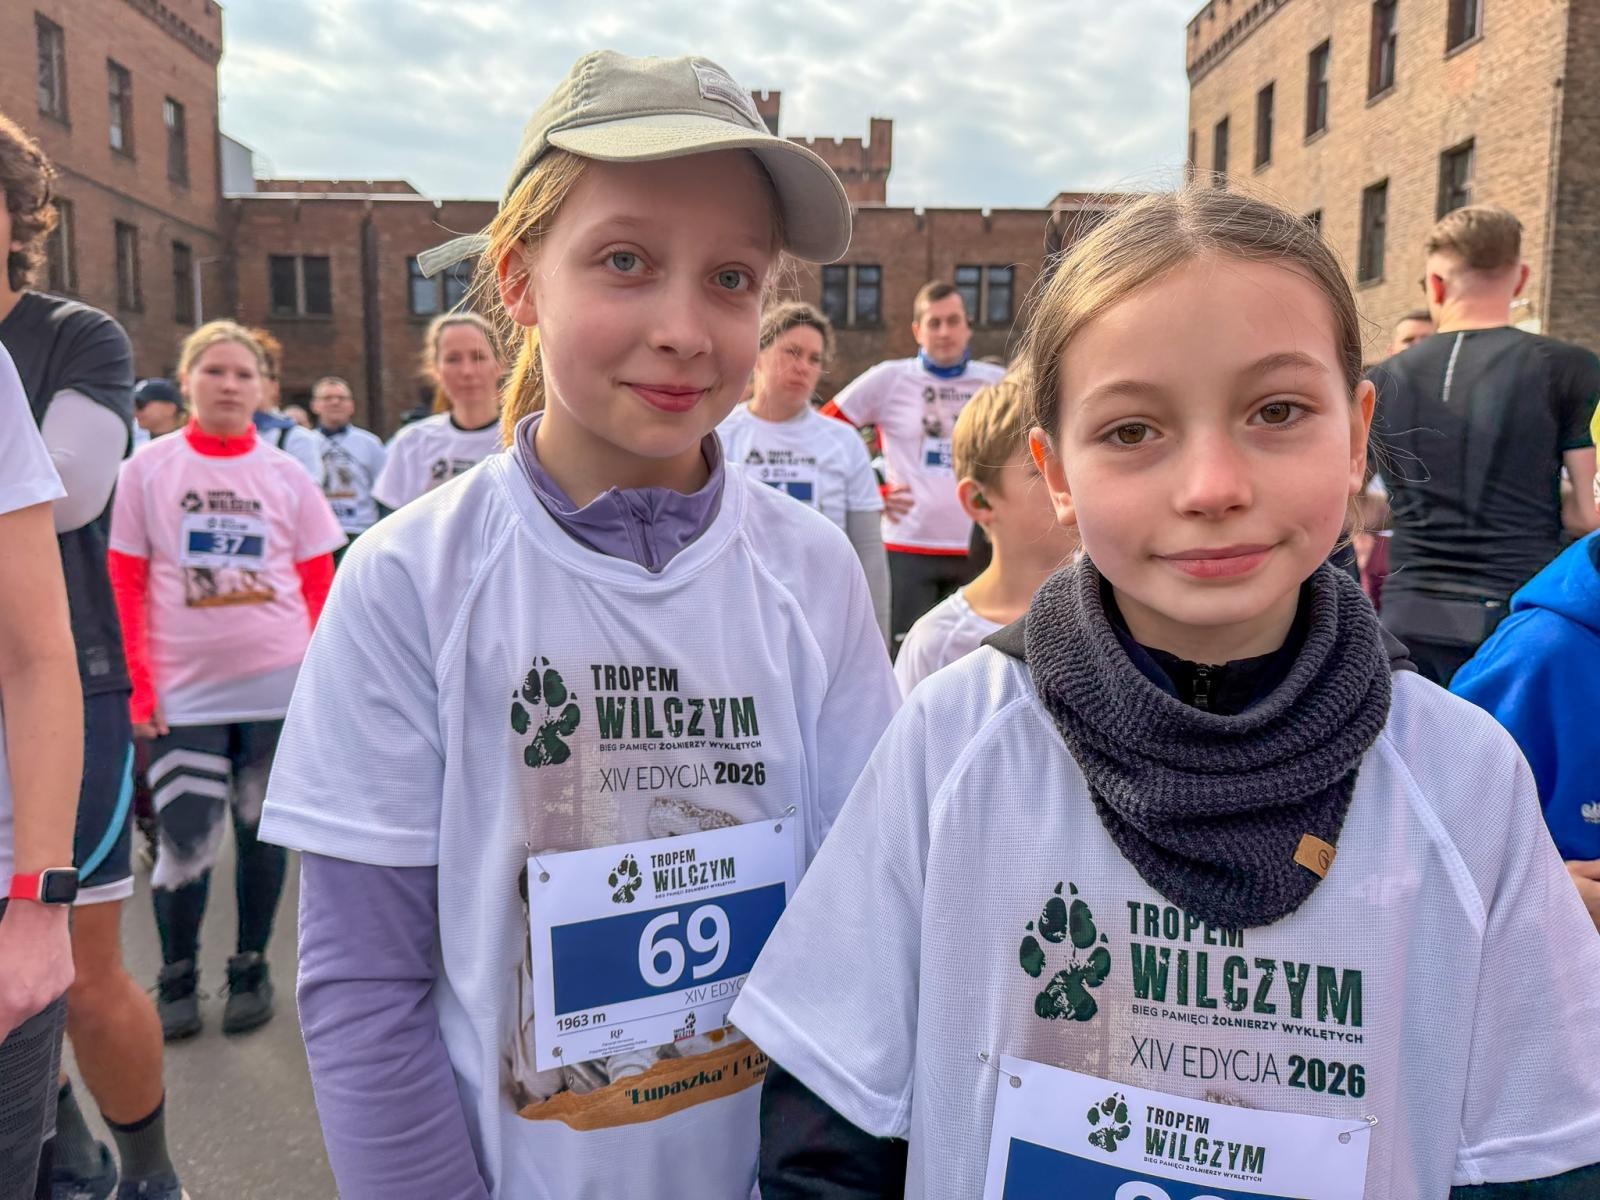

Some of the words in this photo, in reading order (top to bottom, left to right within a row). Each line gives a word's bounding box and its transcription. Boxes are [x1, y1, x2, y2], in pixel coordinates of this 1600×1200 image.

[212, 533, 246, 555] 37
[590, 664, 679, 692] TROPEM
[595, 696, 760, 739] WILCZYM
[600, 744, 617, 752] BIEG
[619, 743, 656, 752] PAMIĘCI
[659, 740, 706, 750] ŻOŁNIERZY
[709, 740, 762, 751] WYKLĘTYCH
[600, 767, 631, 793] XIV
[637, 763, 712, 790] EDYCJA
[714, 760, 766, 786] 2026
[650, 848, 696, 869] TROPEM
[652, 857, 736, 893] WILCZYM
[638, 904, 731, 988] 69
[684, 987, 707, 1004] XIV
[711, 977, 747, 998] EDYC
[1129, 942, 1363, 1028] WILCZYM
[556, 1013, 589, 1031] 1963
[592, 1012, 607, 1024] m
[1132, 1004, 1159, 1017] BIEG
[1162, 1009, 1209, 1025] PAMIĘCI
[1212, 1013, 1278, 1031] ŻOŁNIERZY
[1281, 1022, 1363, 1044] WYKLĘTYCH
[1130, 1035, 1174, 1072] XIV
[1183, 1045, 1281, 1085] EDYCJA
[1288, 1054, 1366, 1099] 2026
[1146, 1105, 1210, 1135] TROPEM
[1145, 1126, 1266, 1174] WILCZYM
[1143, 1156, 1158, 1165] BIEG
[1159, 1159, 1185, 1171] PAMIĘCI
[1223, 1171, 1262, 1183] WYKLĘTYCH
